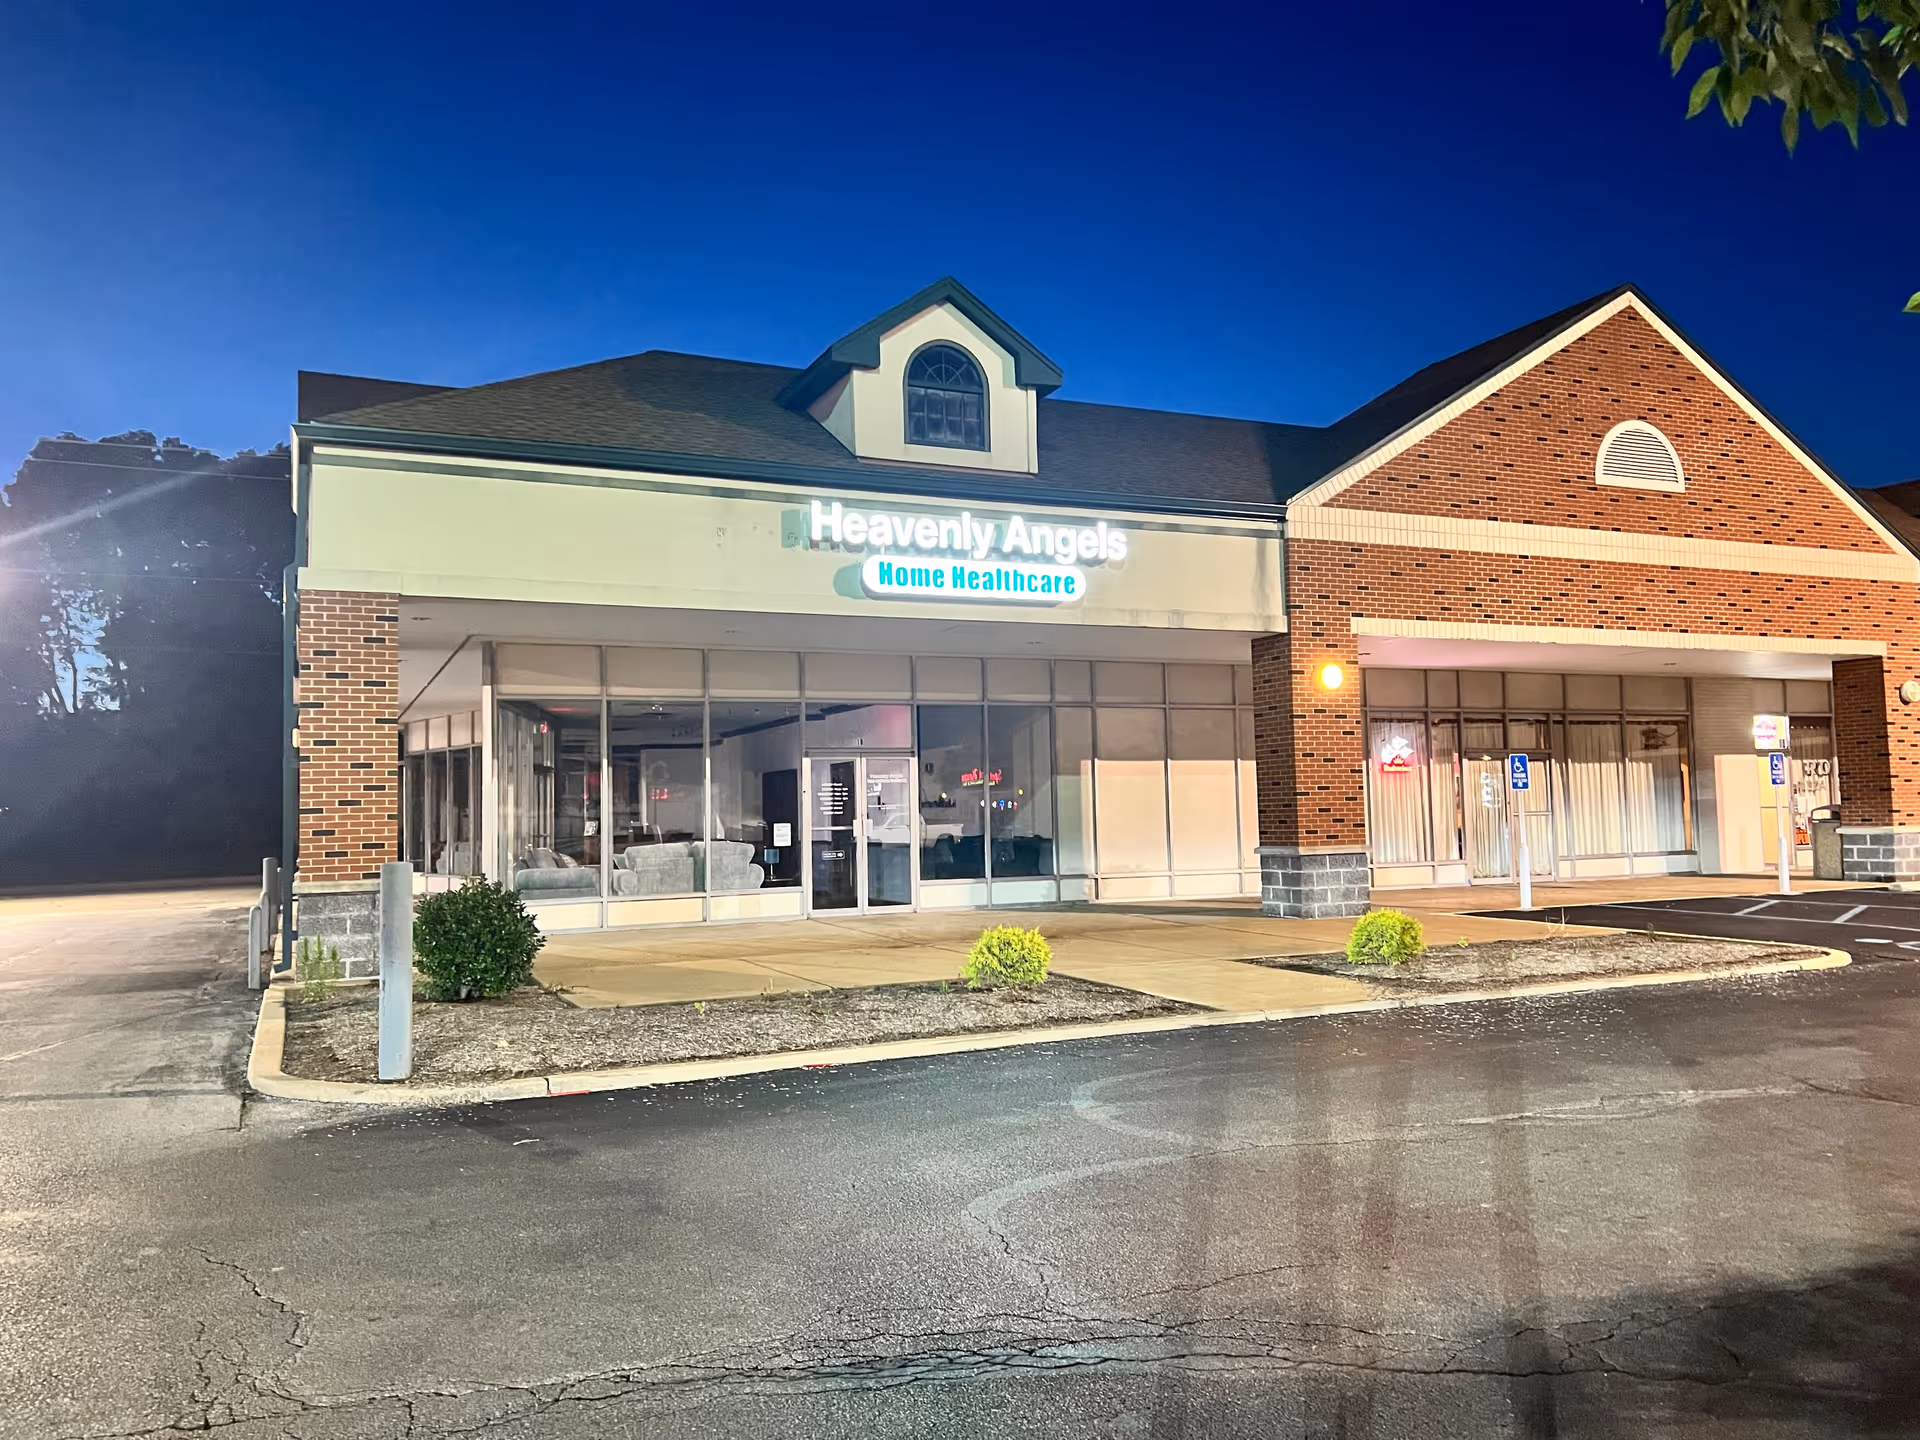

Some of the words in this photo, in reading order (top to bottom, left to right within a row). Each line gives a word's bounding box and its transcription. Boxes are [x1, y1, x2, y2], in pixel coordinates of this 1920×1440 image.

[811, 500, 995, 560] Heavenly
[1002, 515, 1128, 565] Angels
[879, 561, 945, 588] Home
[952, 566, 1075, 594] Healthcare
